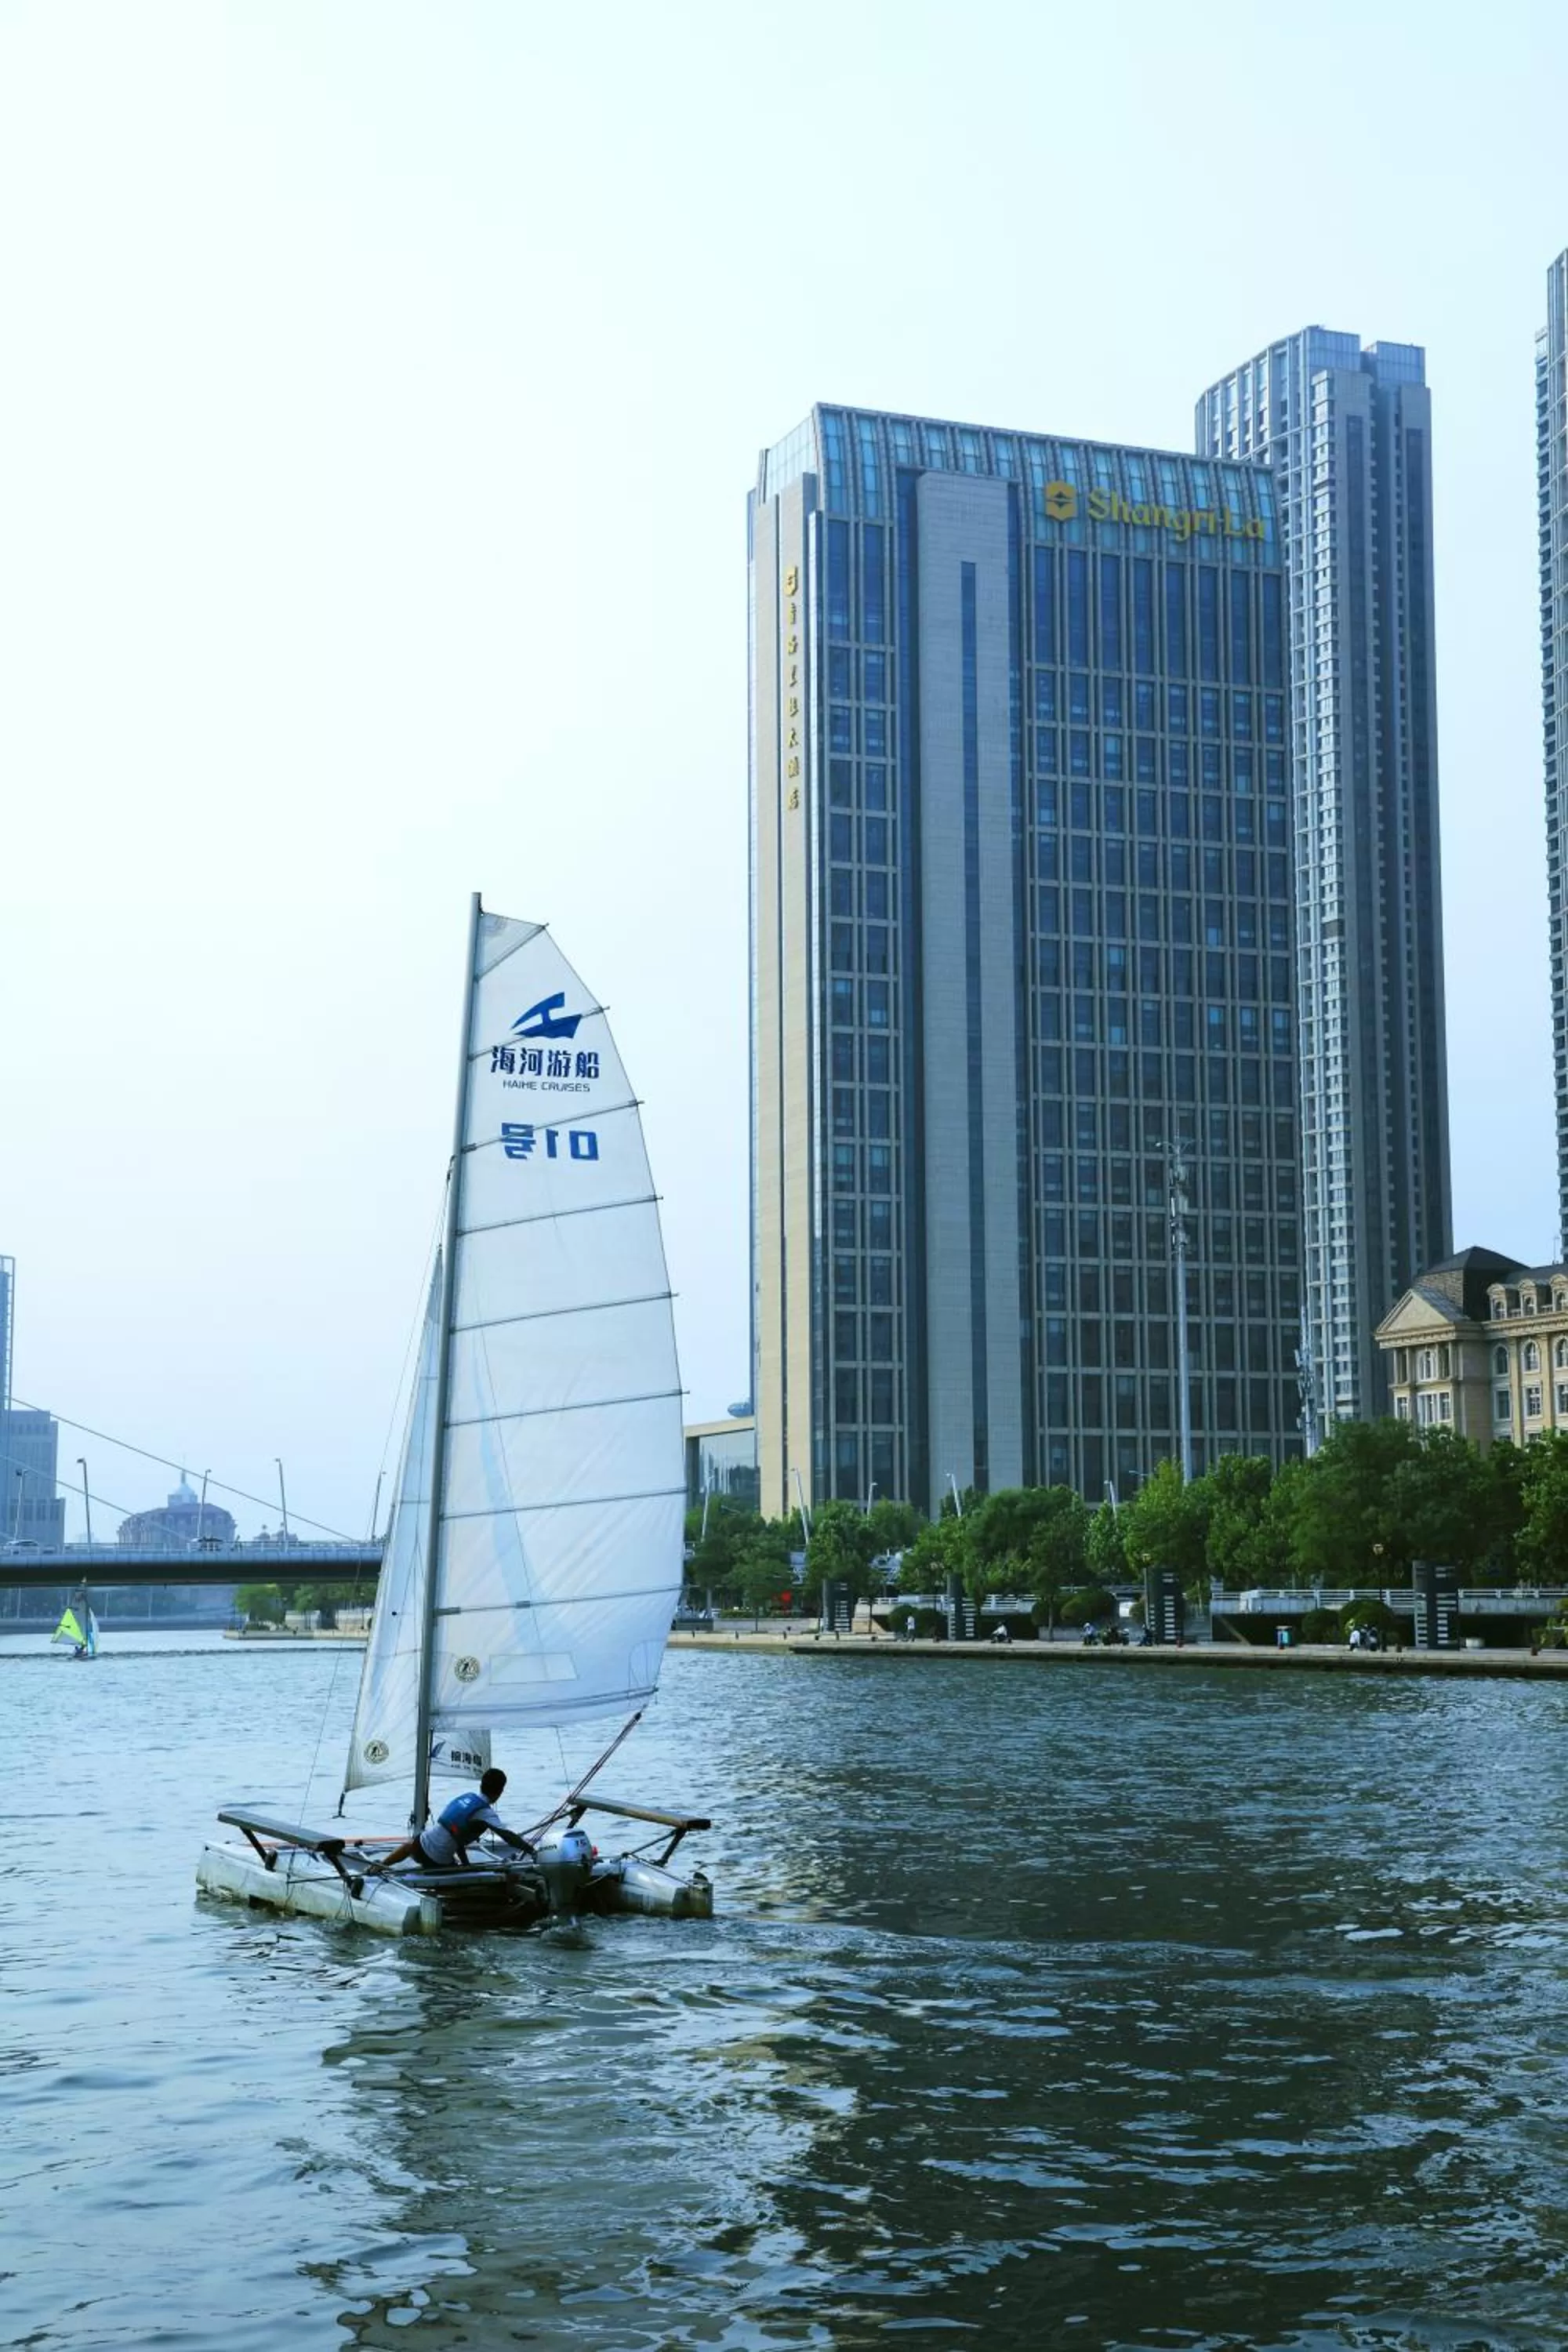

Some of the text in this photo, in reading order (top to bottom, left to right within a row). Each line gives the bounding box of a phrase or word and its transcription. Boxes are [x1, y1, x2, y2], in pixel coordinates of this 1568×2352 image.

[491, 1045, 599, 1079] 海河游船
[503, 1080, 590, 1092] HAIHE CRUISES
